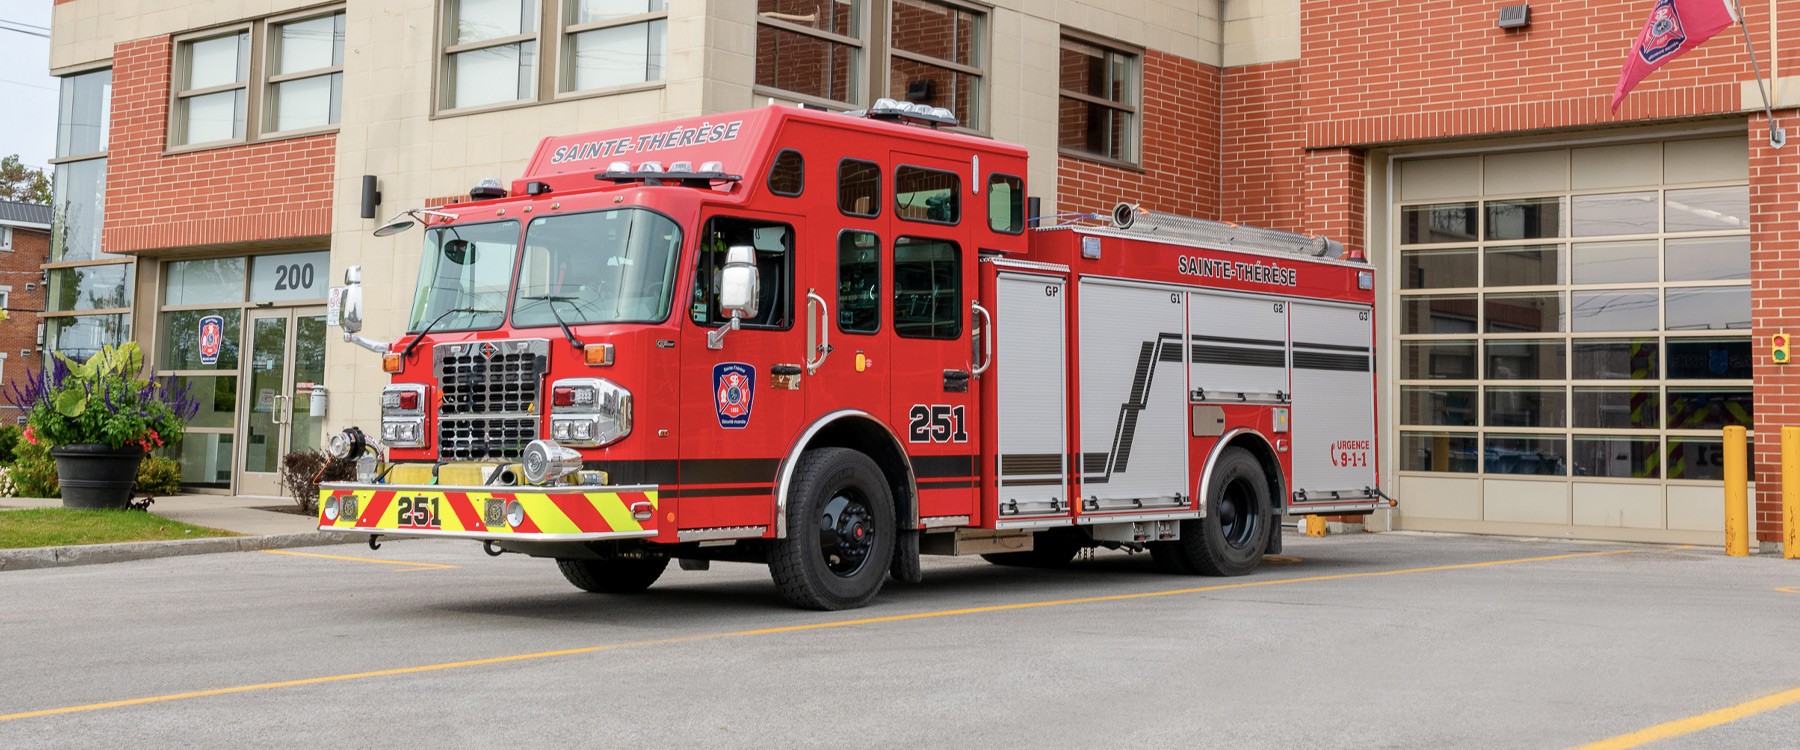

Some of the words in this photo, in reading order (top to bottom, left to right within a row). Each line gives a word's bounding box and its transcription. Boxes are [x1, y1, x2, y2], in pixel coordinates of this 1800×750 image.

[551, 120, 742, 164] SAINTE-THÉRÈSE
[275, 263, 314, 290] 200
[1179, 255, 1296, 286] SAINTE-THÉRÈSE
[1045, 286, 1058, 297] GP
[1171, 293, 1180, 304] G1
[1274, 304, 1283, 313] G2
[1359, 312, 1367, 321] G3
[909, 404, 968, 443] 251
[1337, 440, 1369, 450] URGENCE
[1341, 452, 1367, 467] 9-1-1
[398, 496, 441, 526] 251
